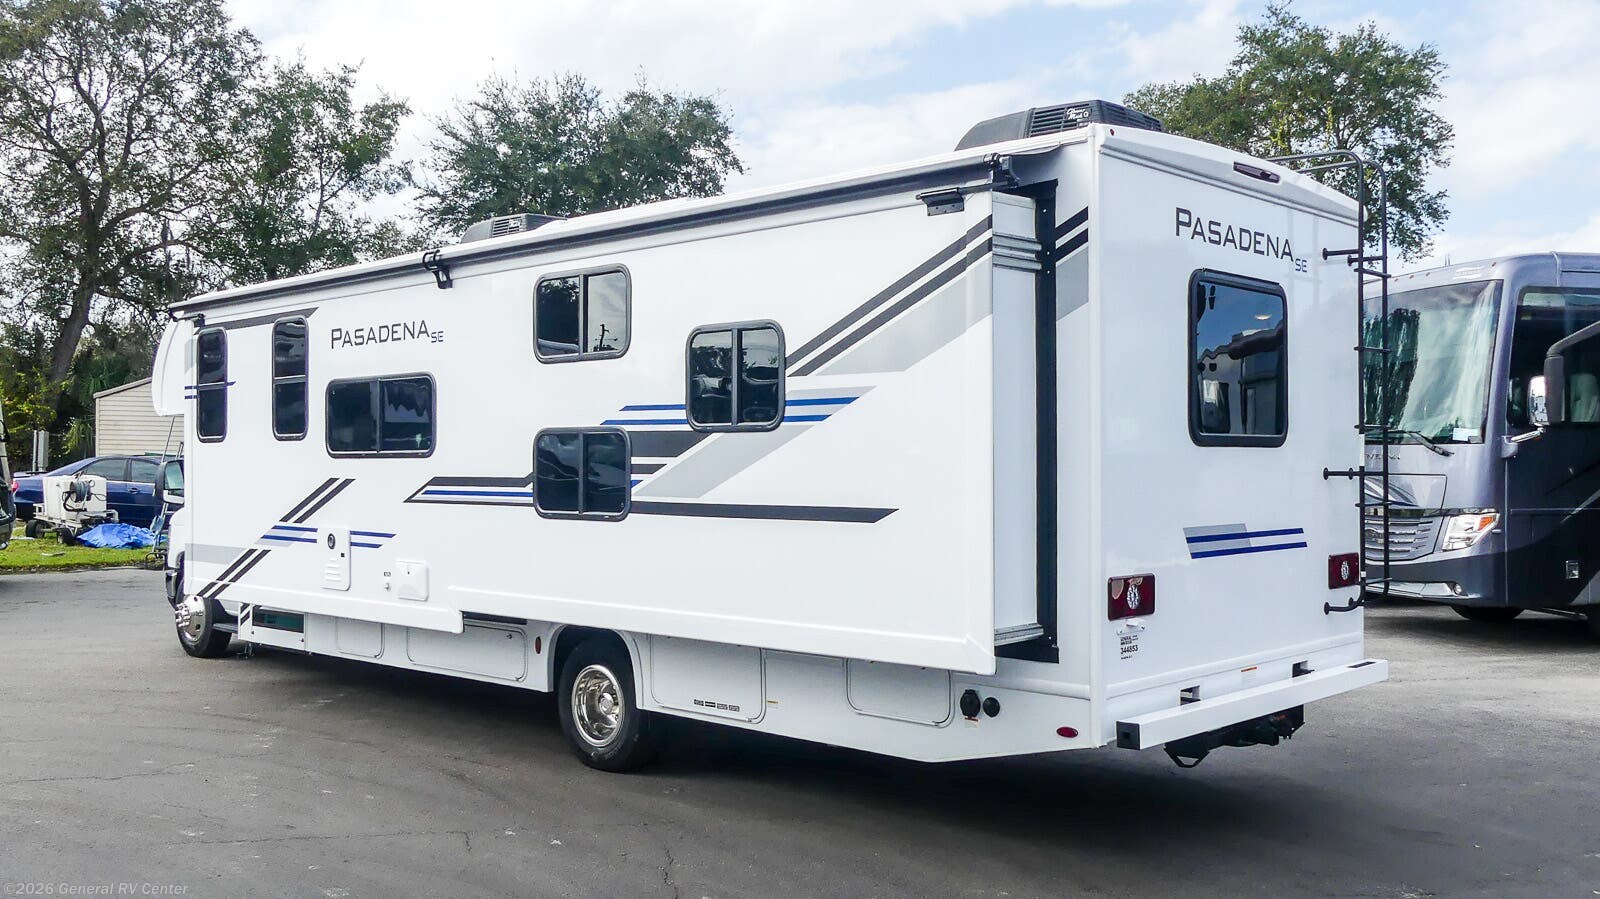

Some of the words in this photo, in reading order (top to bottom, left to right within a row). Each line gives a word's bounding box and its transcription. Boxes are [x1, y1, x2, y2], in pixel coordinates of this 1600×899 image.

[1175, 206, 1293, 262] PASADENA
[1295, 258, 1308, 273] SE
[331, 319, 430, 349] PASADENA
[431, 330, 444, 343] SE
